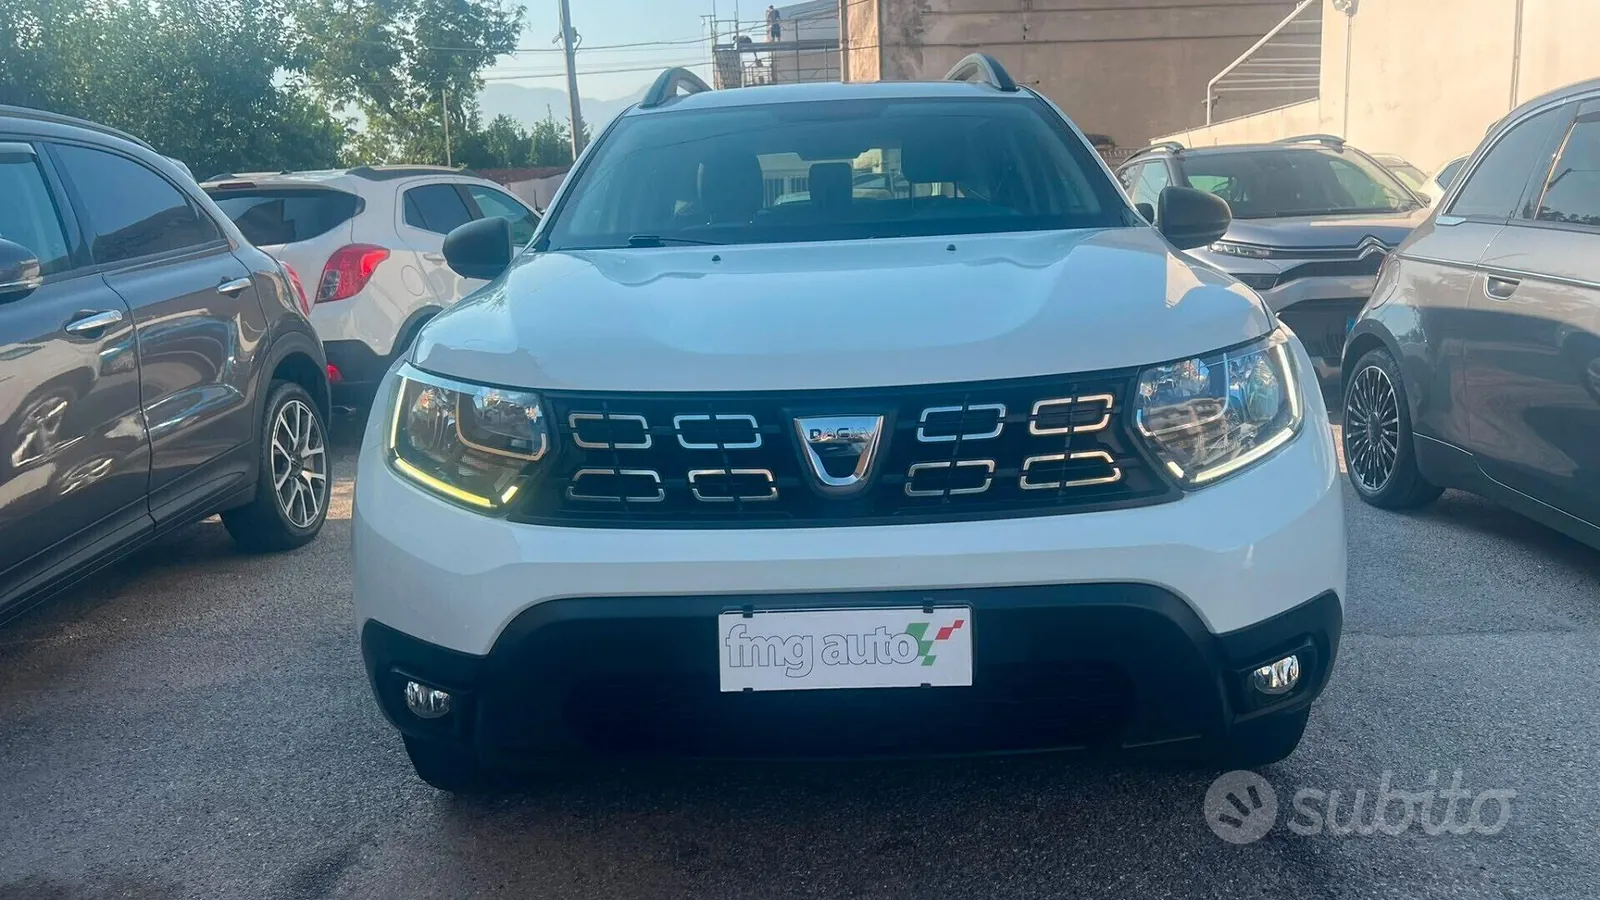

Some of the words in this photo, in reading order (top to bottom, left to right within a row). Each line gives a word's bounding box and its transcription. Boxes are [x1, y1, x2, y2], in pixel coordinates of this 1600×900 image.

[809, 427, 870, 440] DACIA
[725, 623, 814, 678] fmg
[821, 625, 920, 666] auto
